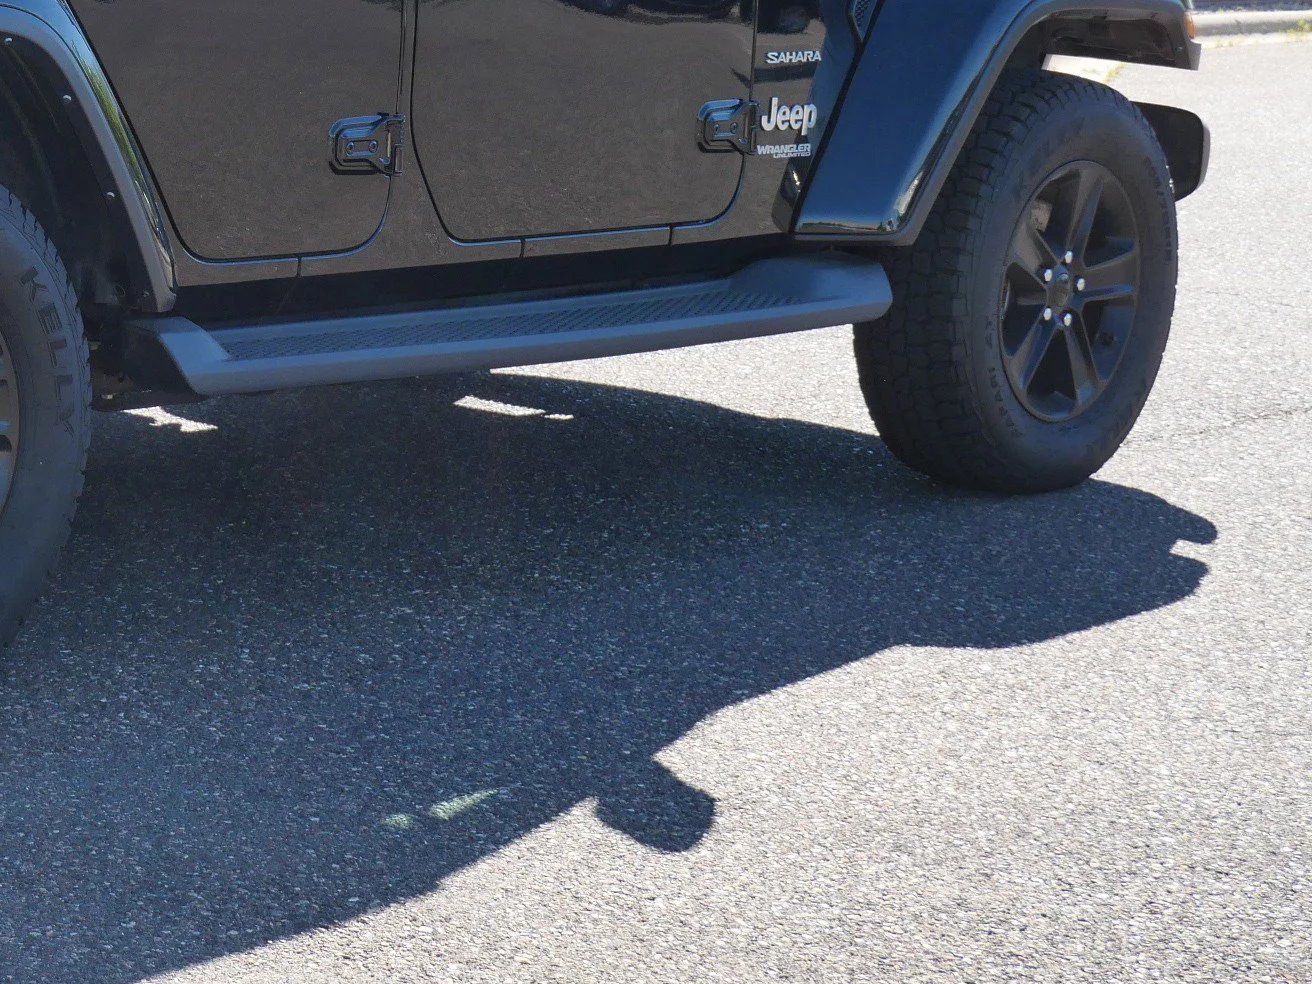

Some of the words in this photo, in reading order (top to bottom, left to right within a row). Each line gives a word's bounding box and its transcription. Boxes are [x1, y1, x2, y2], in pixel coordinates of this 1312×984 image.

[766, 50, 822, 64] SAHARA
[761, 96, 818, 136] Jeep
[756, 143, 811, 155] WRANGLER
[20, 266, 77, 438] KELLY
